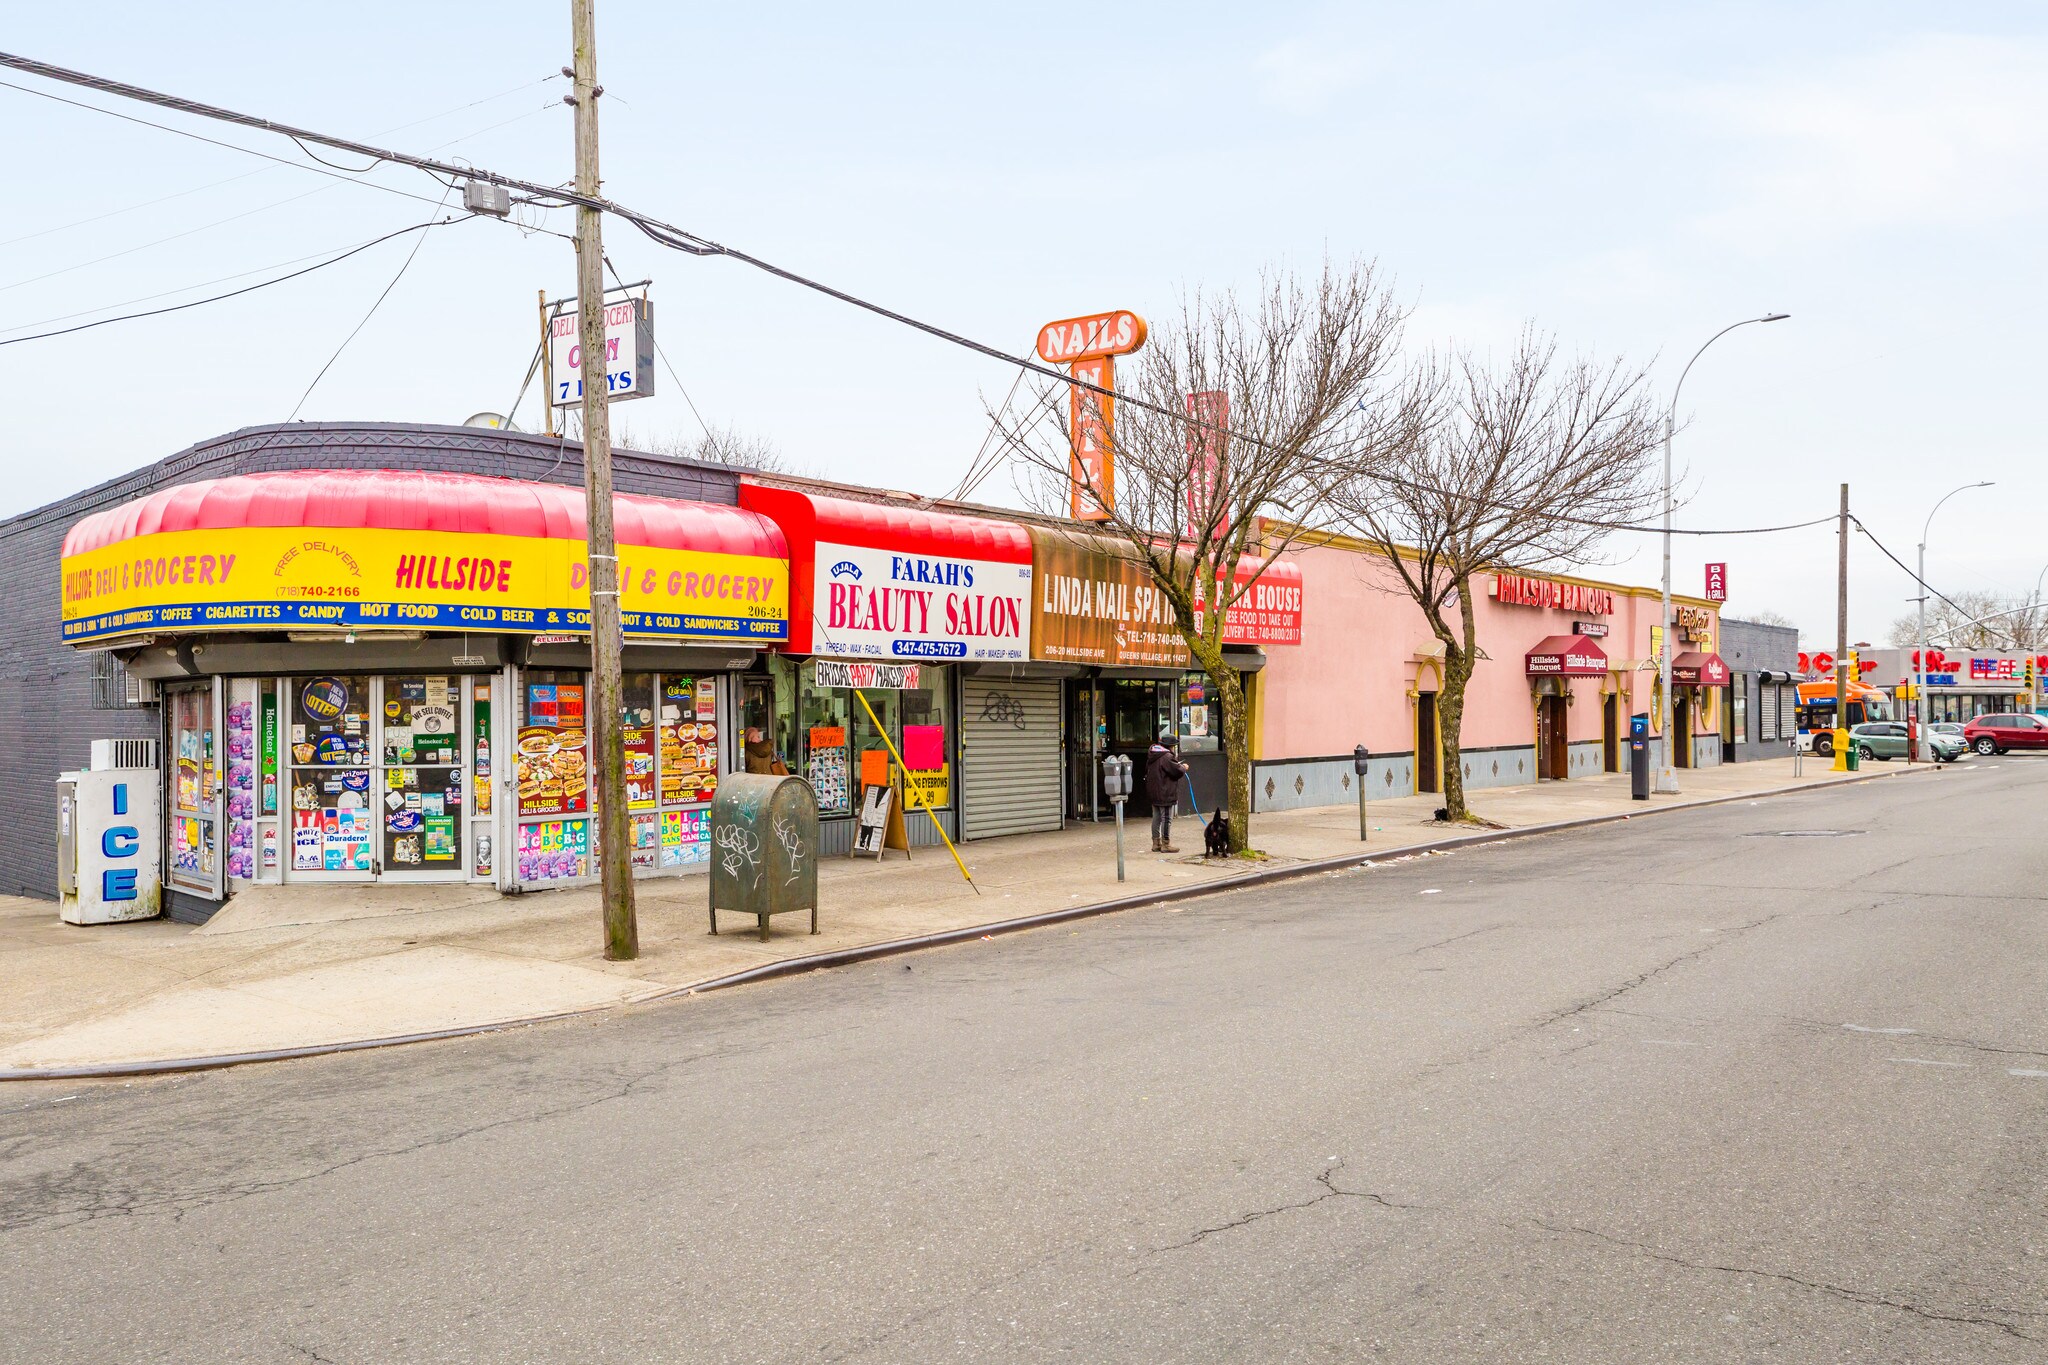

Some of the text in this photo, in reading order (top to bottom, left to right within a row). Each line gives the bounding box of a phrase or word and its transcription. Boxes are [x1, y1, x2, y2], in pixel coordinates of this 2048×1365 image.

[553, 317, 575, 338] DELI
[1045, 315, 1132, 358] NAILS
[568, 337, 620, 369] ON
[559, 382, 570, 399] 7
[274, 541, 362, 578] FREE DELIVERY
[66, 554, 236, 602] HILLSIDE DELI & GROCERY
[832, 564, 860, 578] UJALA
[891, 556, 974, 588] FARAH'S
[1710, 566, 1722, 589] BAR
[396, 555, 774, 603] HILLSIDE DI & GROCERY
[276, 586, 360, 598] (718)740-2166
[1043, 574, 1091, 618] LINDA
[1096, 581, 1130, 621] NAIL
[1134, 586, 1160, 624] SPA
[1257, 584, 1300, 612] HOUSE
[1497, 574, 1616, 616] HILLSIDE BANQUET
[1711, 590, 1724, 600] GRILL
[748, 606, 783, 619] 206-24
[827, 582, 1022, 638] BEAUTY SALON
[124, 610, 154, 625] SANDWICHES
[161, 607, 193, 621] COFFEE
[206, 605, 281, 619] CIGARETTES
[299, 605, 346, 619] CANDY
[360, 603, 391, 617] HOT
[397, 604, 438, 618] FOOD
[460, 607, 496, 620] COLD
[502, 610, 534, 622] BEER
[547, 612, 559, 623] &
[622, 615, 641, 626] HOT
[645, 616, 652, 627] &
[656, 616, 681, 628] COLD
[684, 618, 739, 631] SANDWICHES
[750, 620, 780, 633] COFFEE
[1240, 611, 1257, 625] FOOD
[1259, 612, 1266, 625] TO
[1268, 613, 1281, 627] TAKE
[1283, 614, 1293, 627] OUT
[537, 635, 572, 643] RELIABLE
[1246, 627, 1257, 640] TEL:
[825, 642, 846, 653] THREAD
[850, 644, 861, 653] WAX
[864, 645, 882, 655] FACIAL
[896, 641, 961, 655] 347-475-7672
[975, 650, 1022, 659] HAIR MAKEUP HENNA
[1045, 646, 1105, 658] 206-20 HILLSIDE AVE
[1119, 651, 1186, 663] QUEENS VILLAGE, NY, 11427
[1566, 655, 1606, 670] Hillside Banquet
[817, 662, 919, 688] BRIDAL PARTY MAKEUP HAIR
[1530, 664, 1561, 672] Banquet
[331, 685, 344, 698] NEW
[305, 694, 340, 716] LOTTERY
[327, 692, 343, 707] YORK
[412, 707, 453, 720] WE SELL COFFEE
[341, 770, 368, 778] AriZona
[922, 778, 948, 788] EYEBROWS
[666, 790, 695, 798] HILLSIDE
[524, 799, 559, 808] HILLSIDE
[538, 805, 562, 813] GROCERY
[389, 809, 415, 822] AriZona
[296, 829, 319, 837] WHITE
[662, 835, 680, 843] CANS
[682, 833, 699, 842] CANS
[101, 784, 139, 901] ICE
